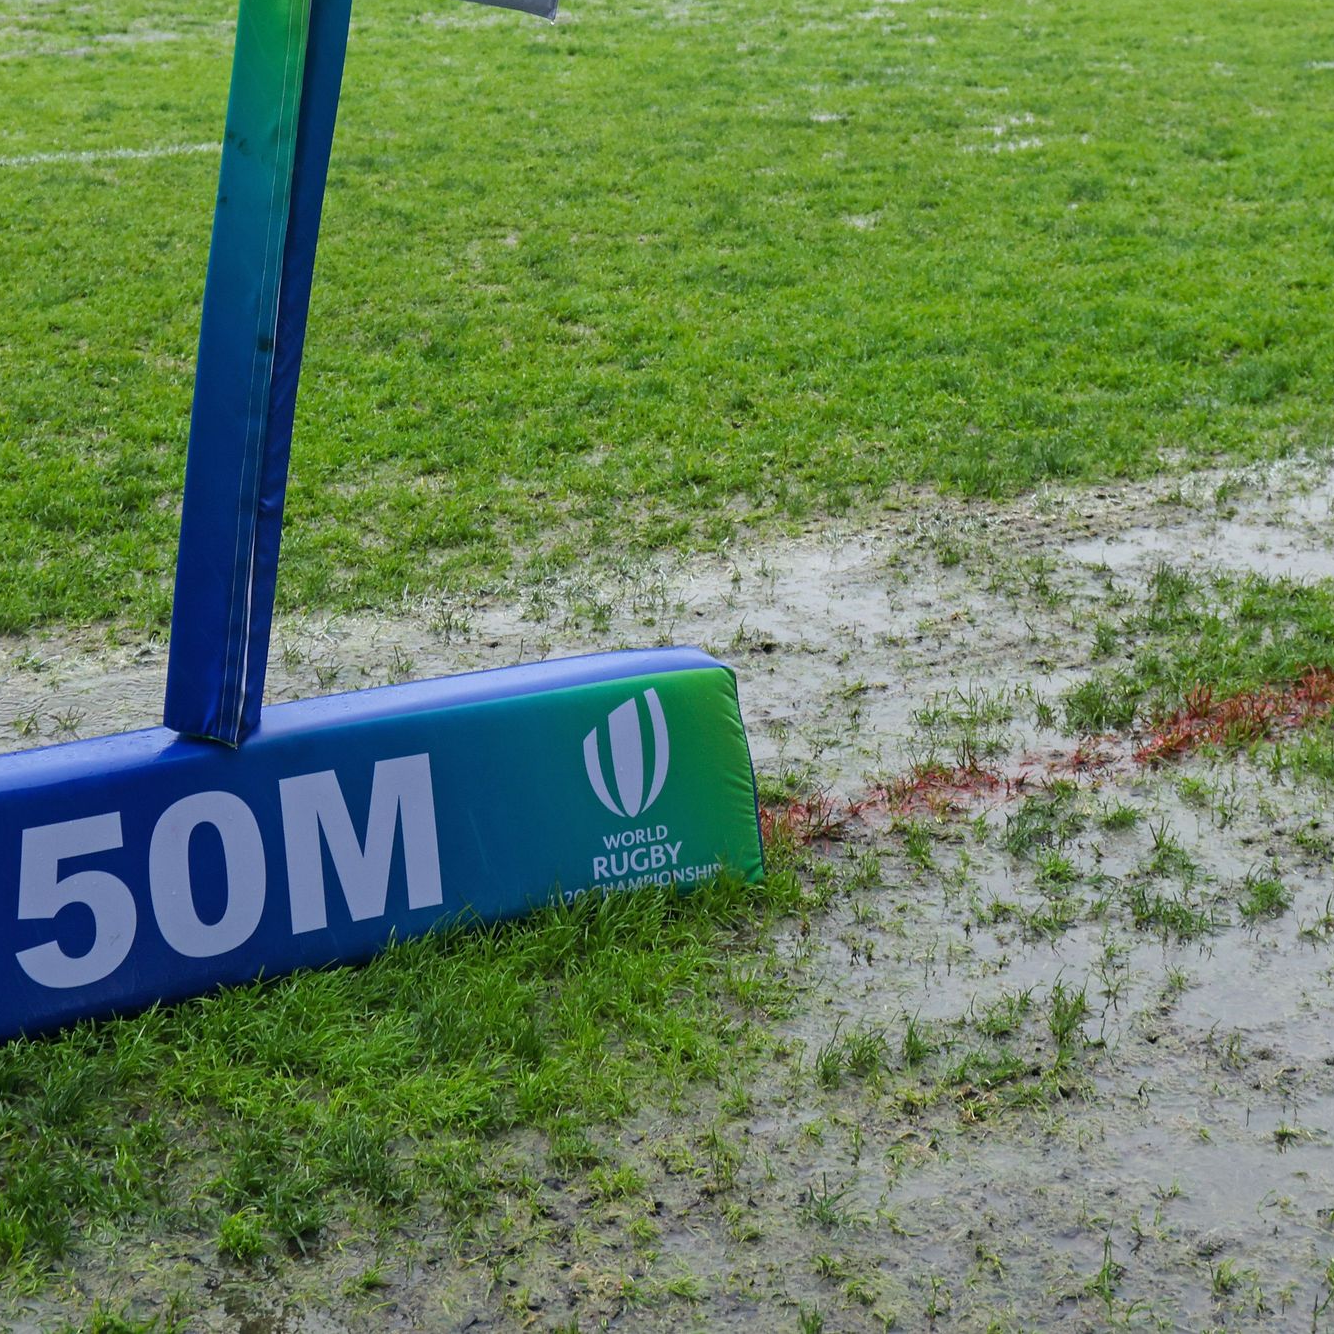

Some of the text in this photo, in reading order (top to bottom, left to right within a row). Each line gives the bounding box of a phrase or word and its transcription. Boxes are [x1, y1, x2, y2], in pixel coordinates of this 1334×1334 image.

[602, 825, 667, 850] WORLD
[16, 751, 443, 990] 50M
[593, 841, 683, 880] RUGBY
